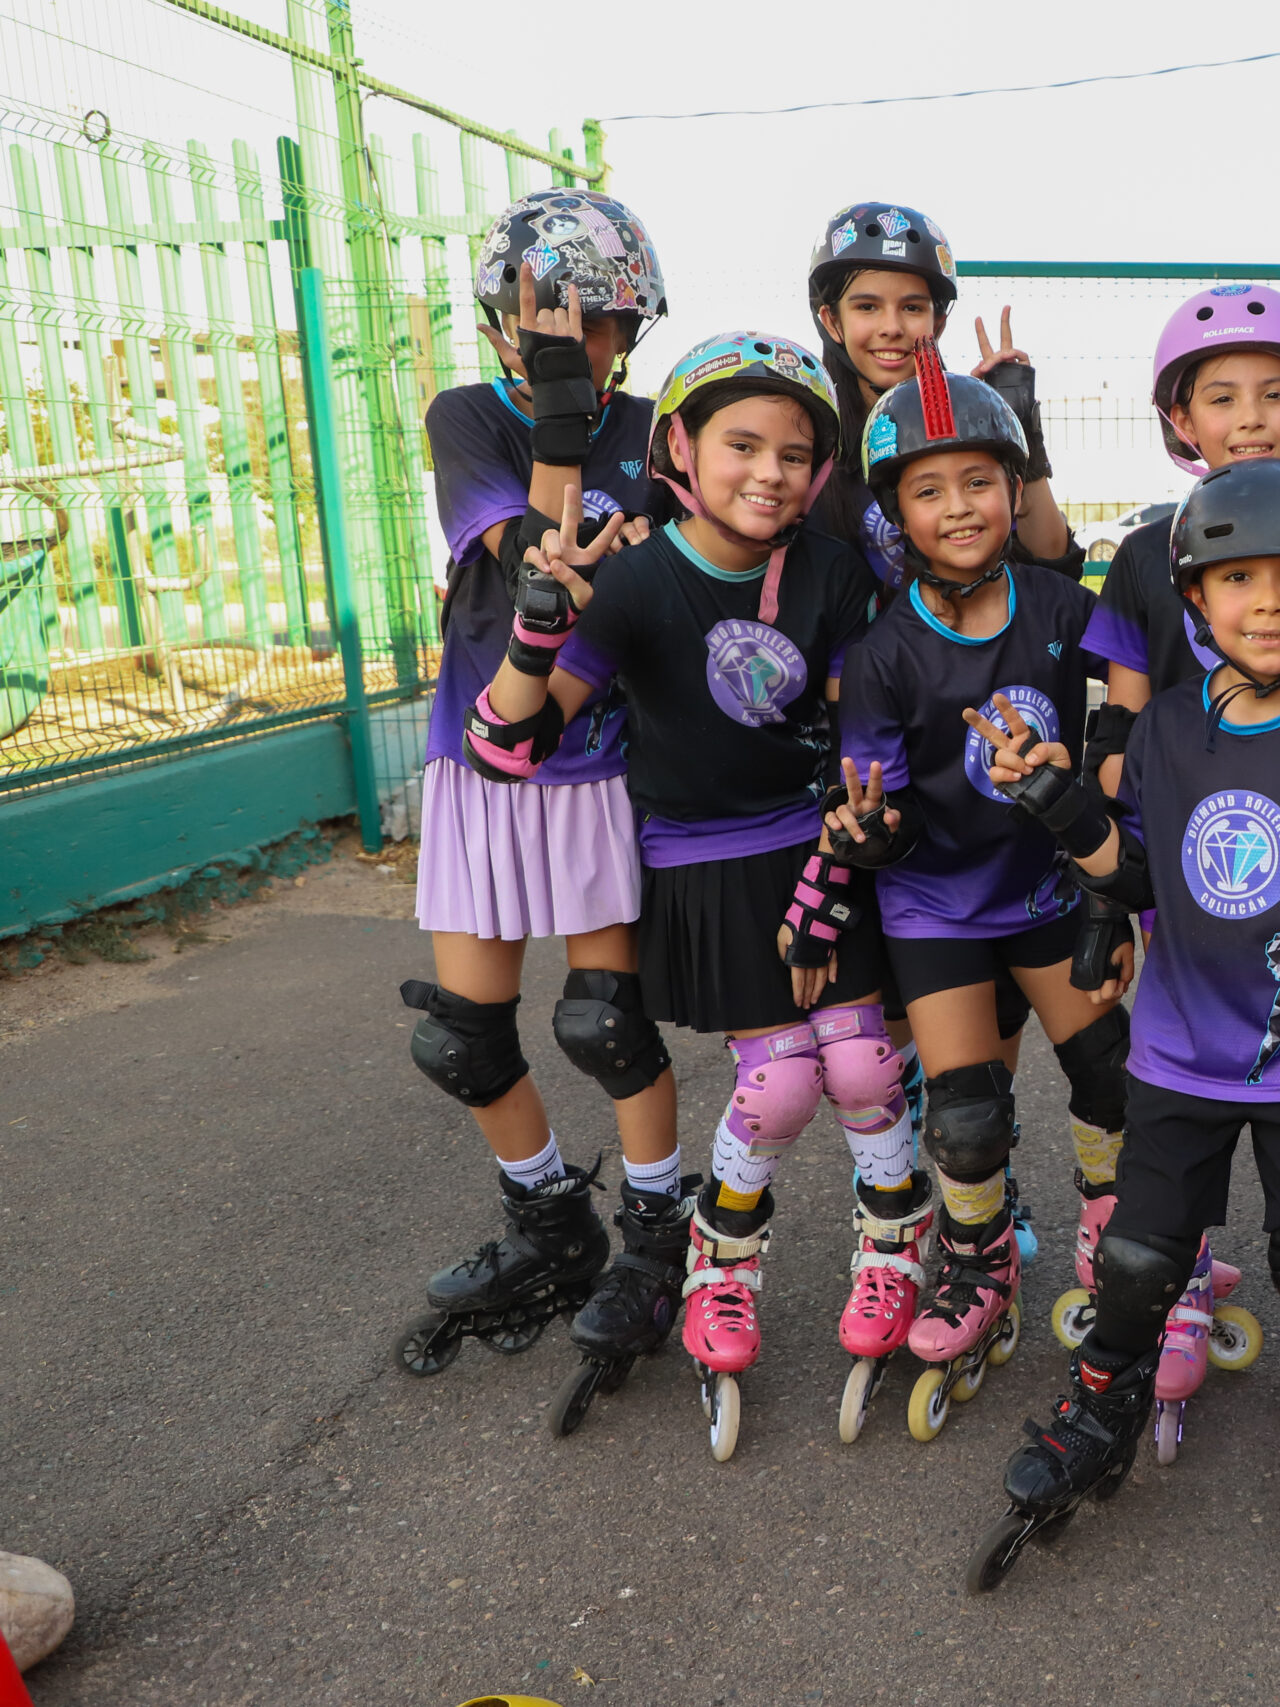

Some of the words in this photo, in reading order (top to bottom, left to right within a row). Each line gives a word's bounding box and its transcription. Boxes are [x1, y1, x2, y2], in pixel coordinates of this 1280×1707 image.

[1202, 326, 1255, 340] ROLLERFACE
[620, 459, 644, 480] DRC
[1009, 689, 1053, 718] ROLLERS
[1188, 794, 1236, 839] DIAMOND
